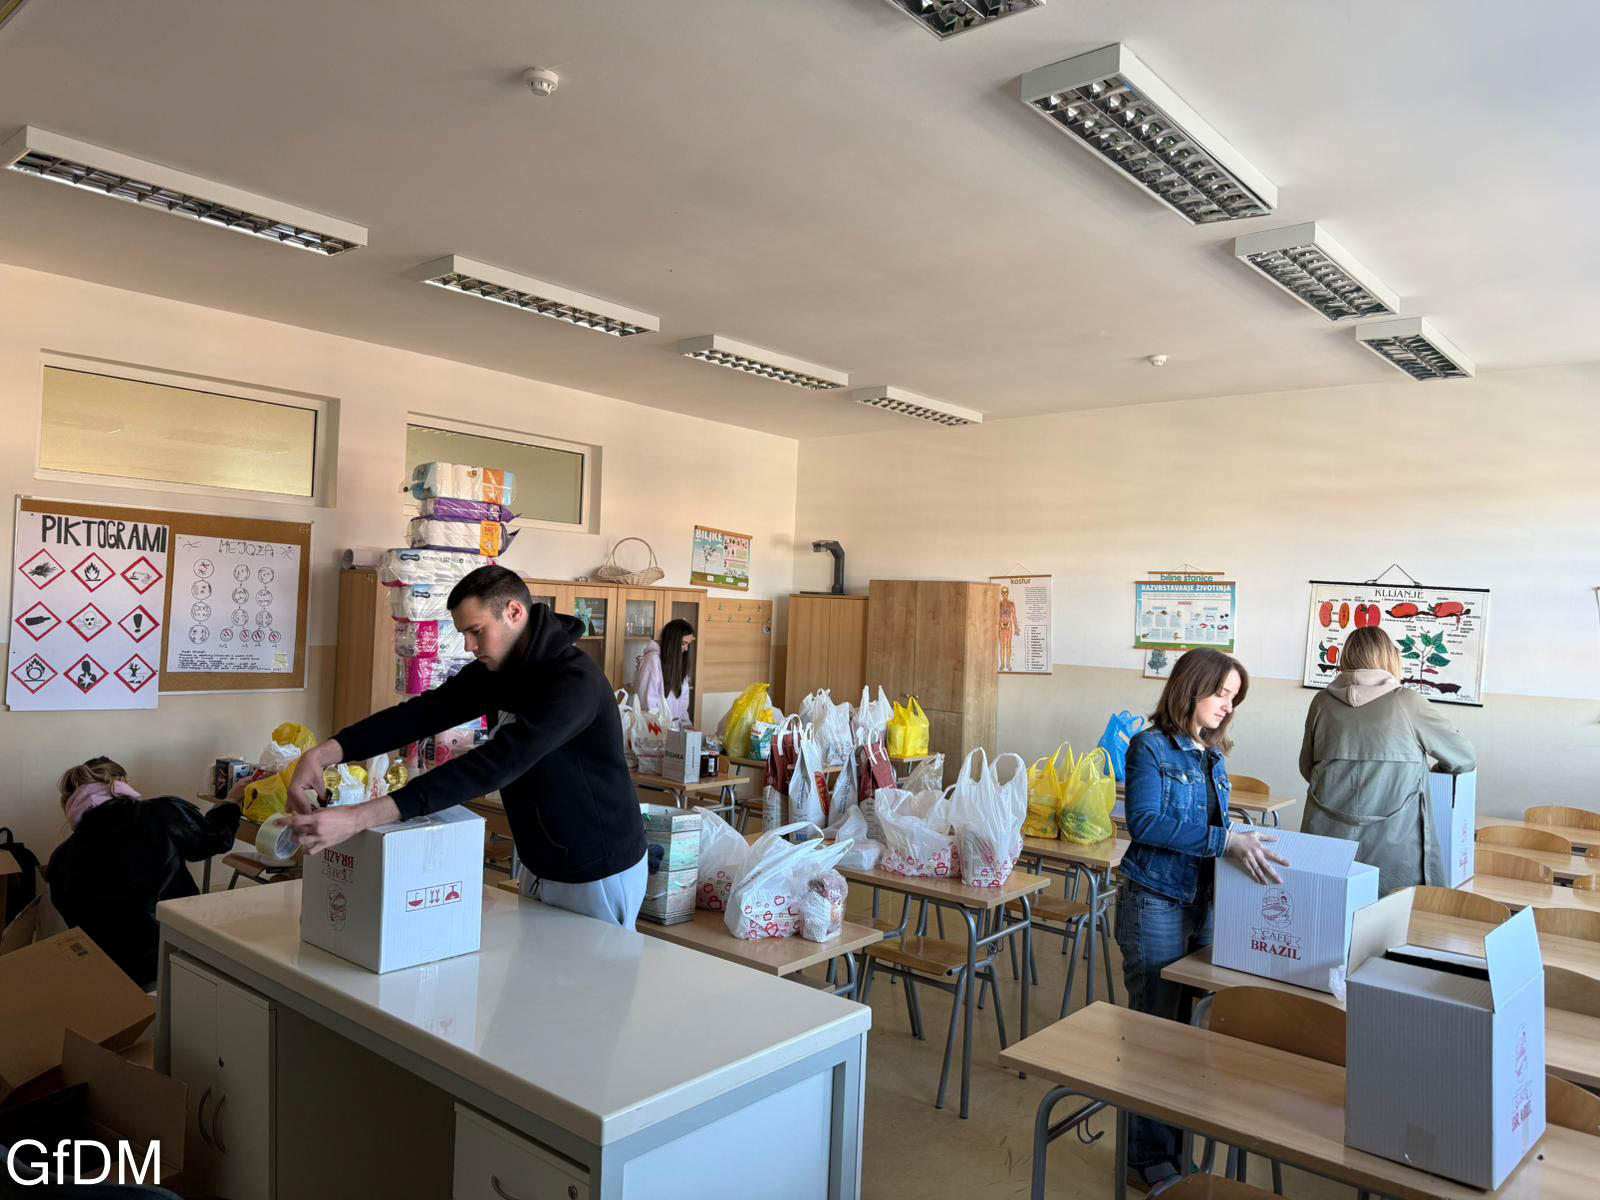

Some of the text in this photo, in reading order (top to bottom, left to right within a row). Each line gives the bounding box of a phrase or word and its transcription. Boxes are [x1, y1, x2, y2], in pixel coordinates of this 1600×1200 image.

[42, 515, 167, 553] PIKTOGRAMI
[695, 529, 724, 542] BILJKE
[219, 539, 275, 557] MEJOZA
[1010, 577, 1032, 585] kostur
[1141, 584, 1232, 593] RAZVRSTAVANJE ŽIVOTINJA
[1375, 589, 1424, 599] KLIJANJE
[1250, 939, 1301, 961] BRAZIL
